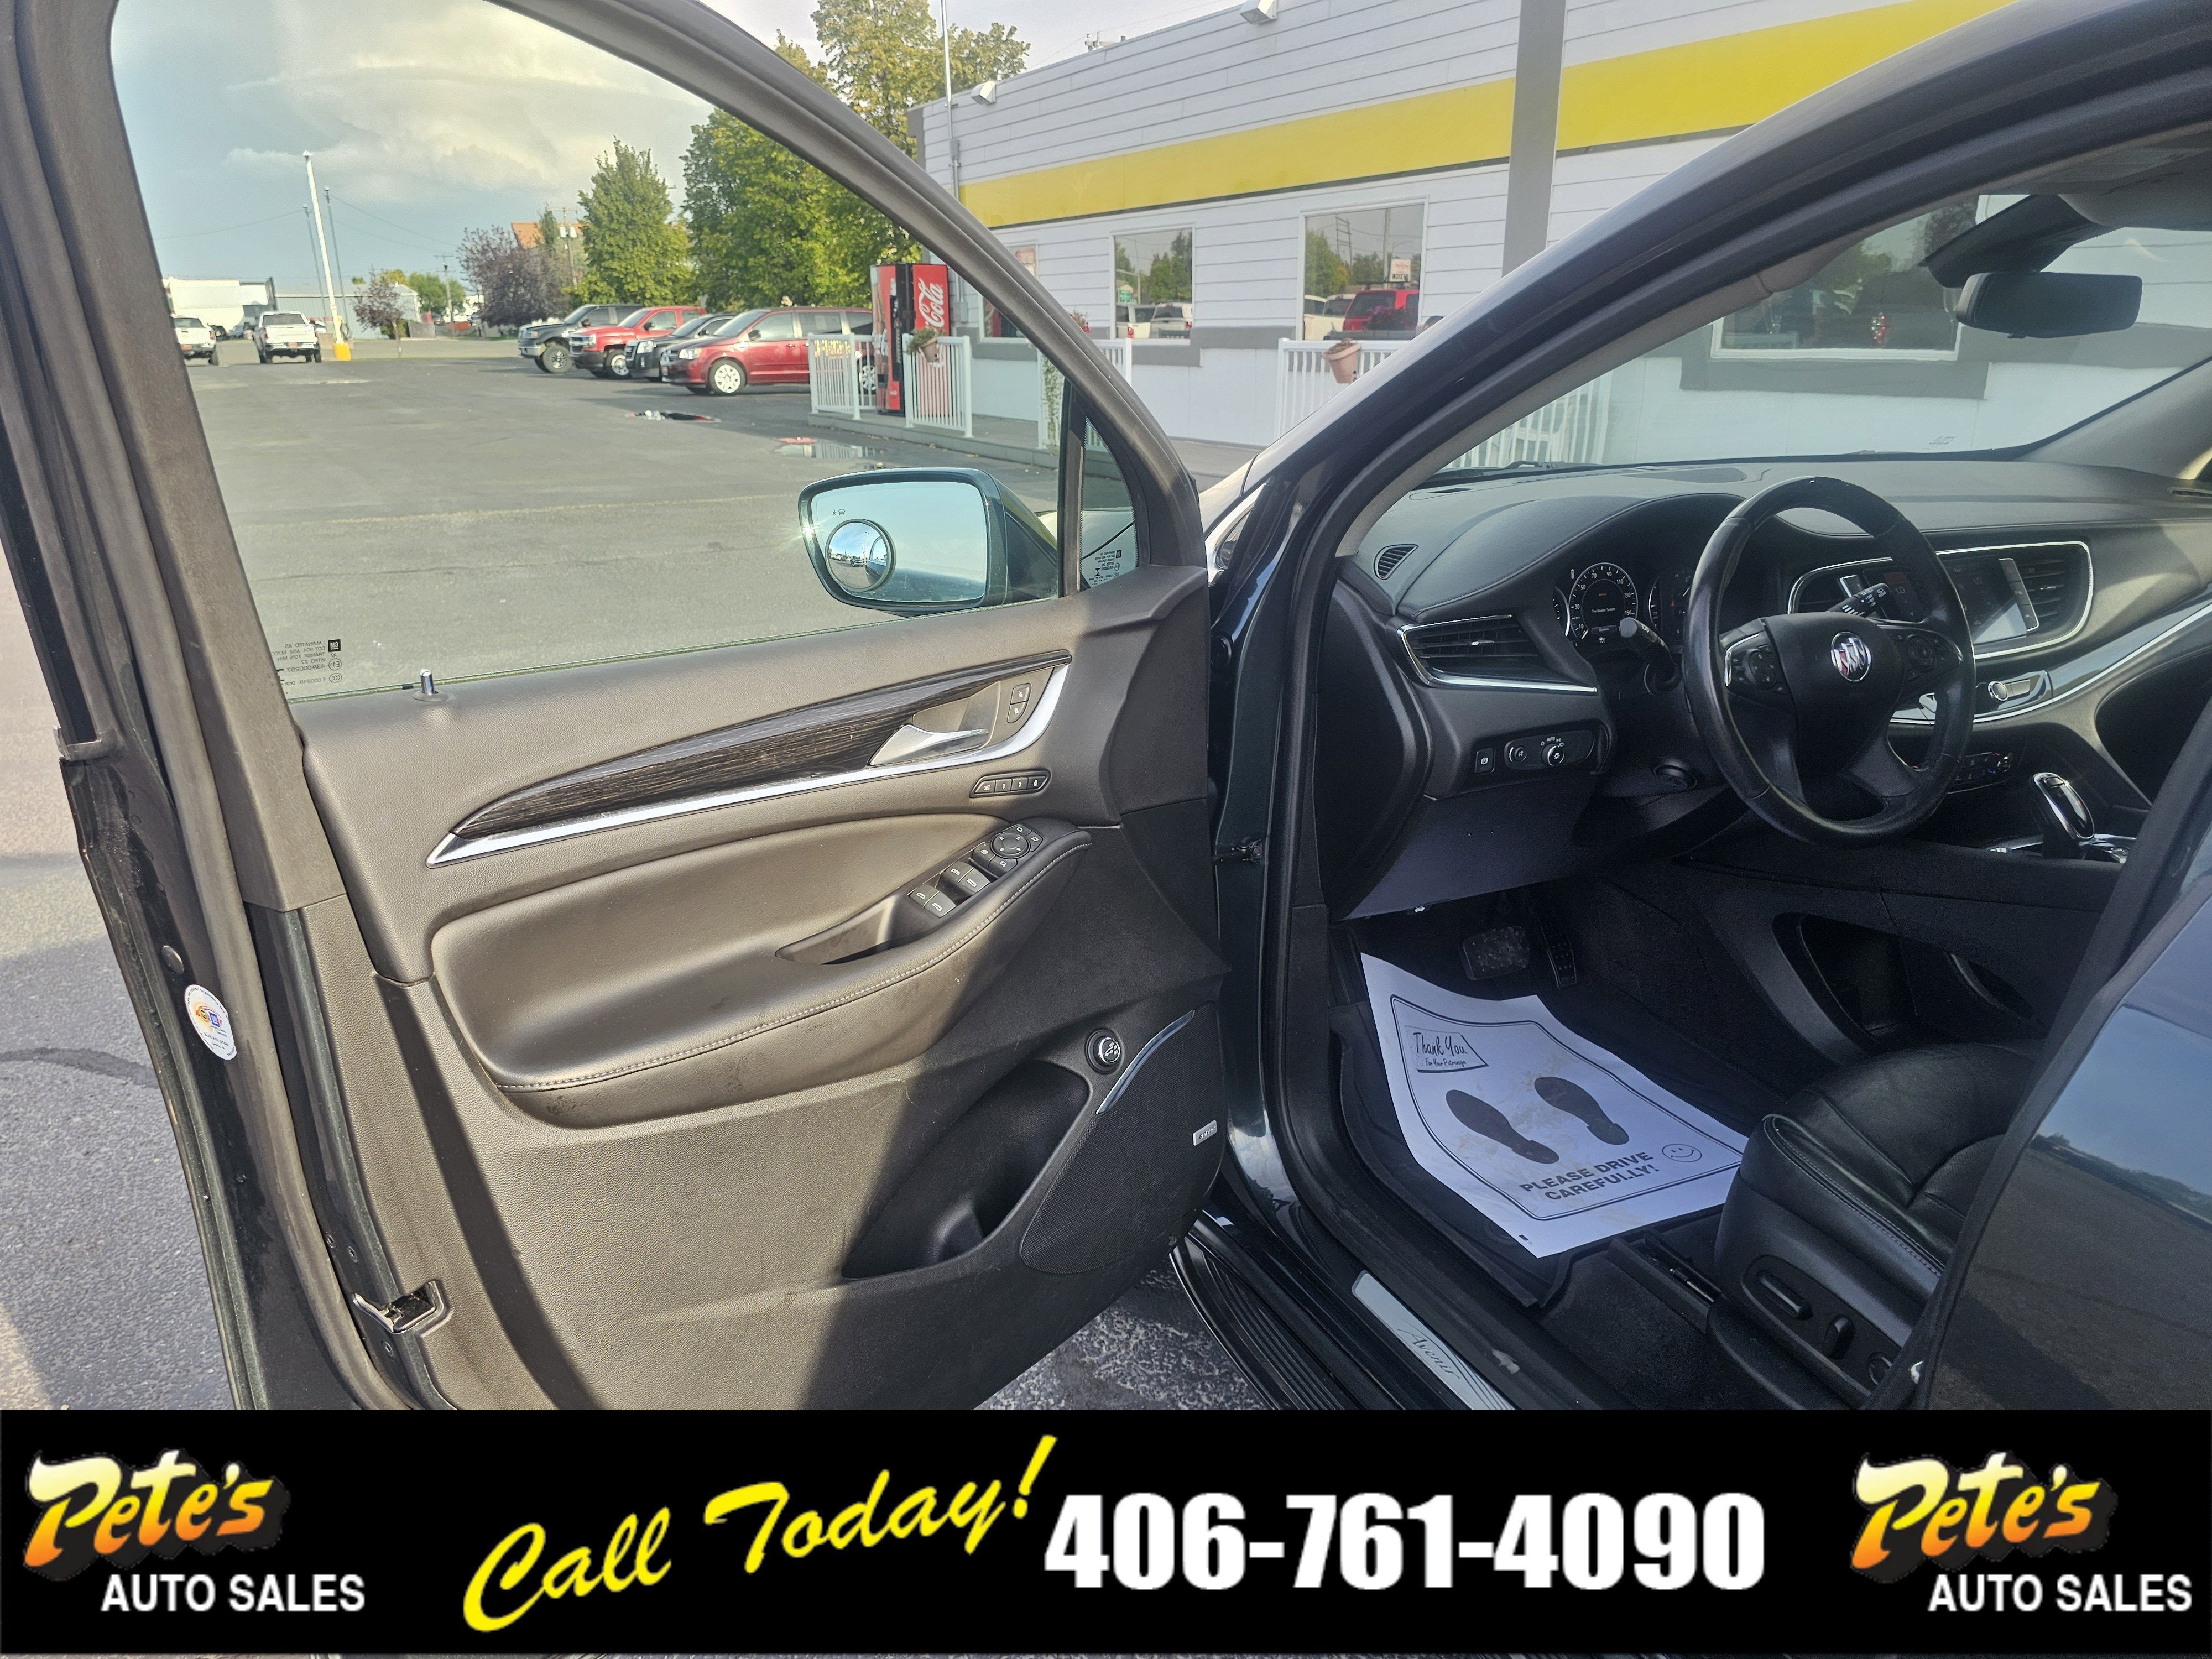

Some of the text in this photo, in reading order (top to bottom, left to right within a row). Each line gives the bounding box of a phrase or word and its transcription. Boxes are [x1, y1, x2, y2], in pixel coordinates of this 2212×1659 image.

[1413, 1032, 1468, 1056] Thank You
[1519, 1152, 1654, 1192] PLEASE DRIVE
[1544, 1164, 1660, 1200] CAREFULLY!
[1397, 1329, 1461, 1380] Avenir
